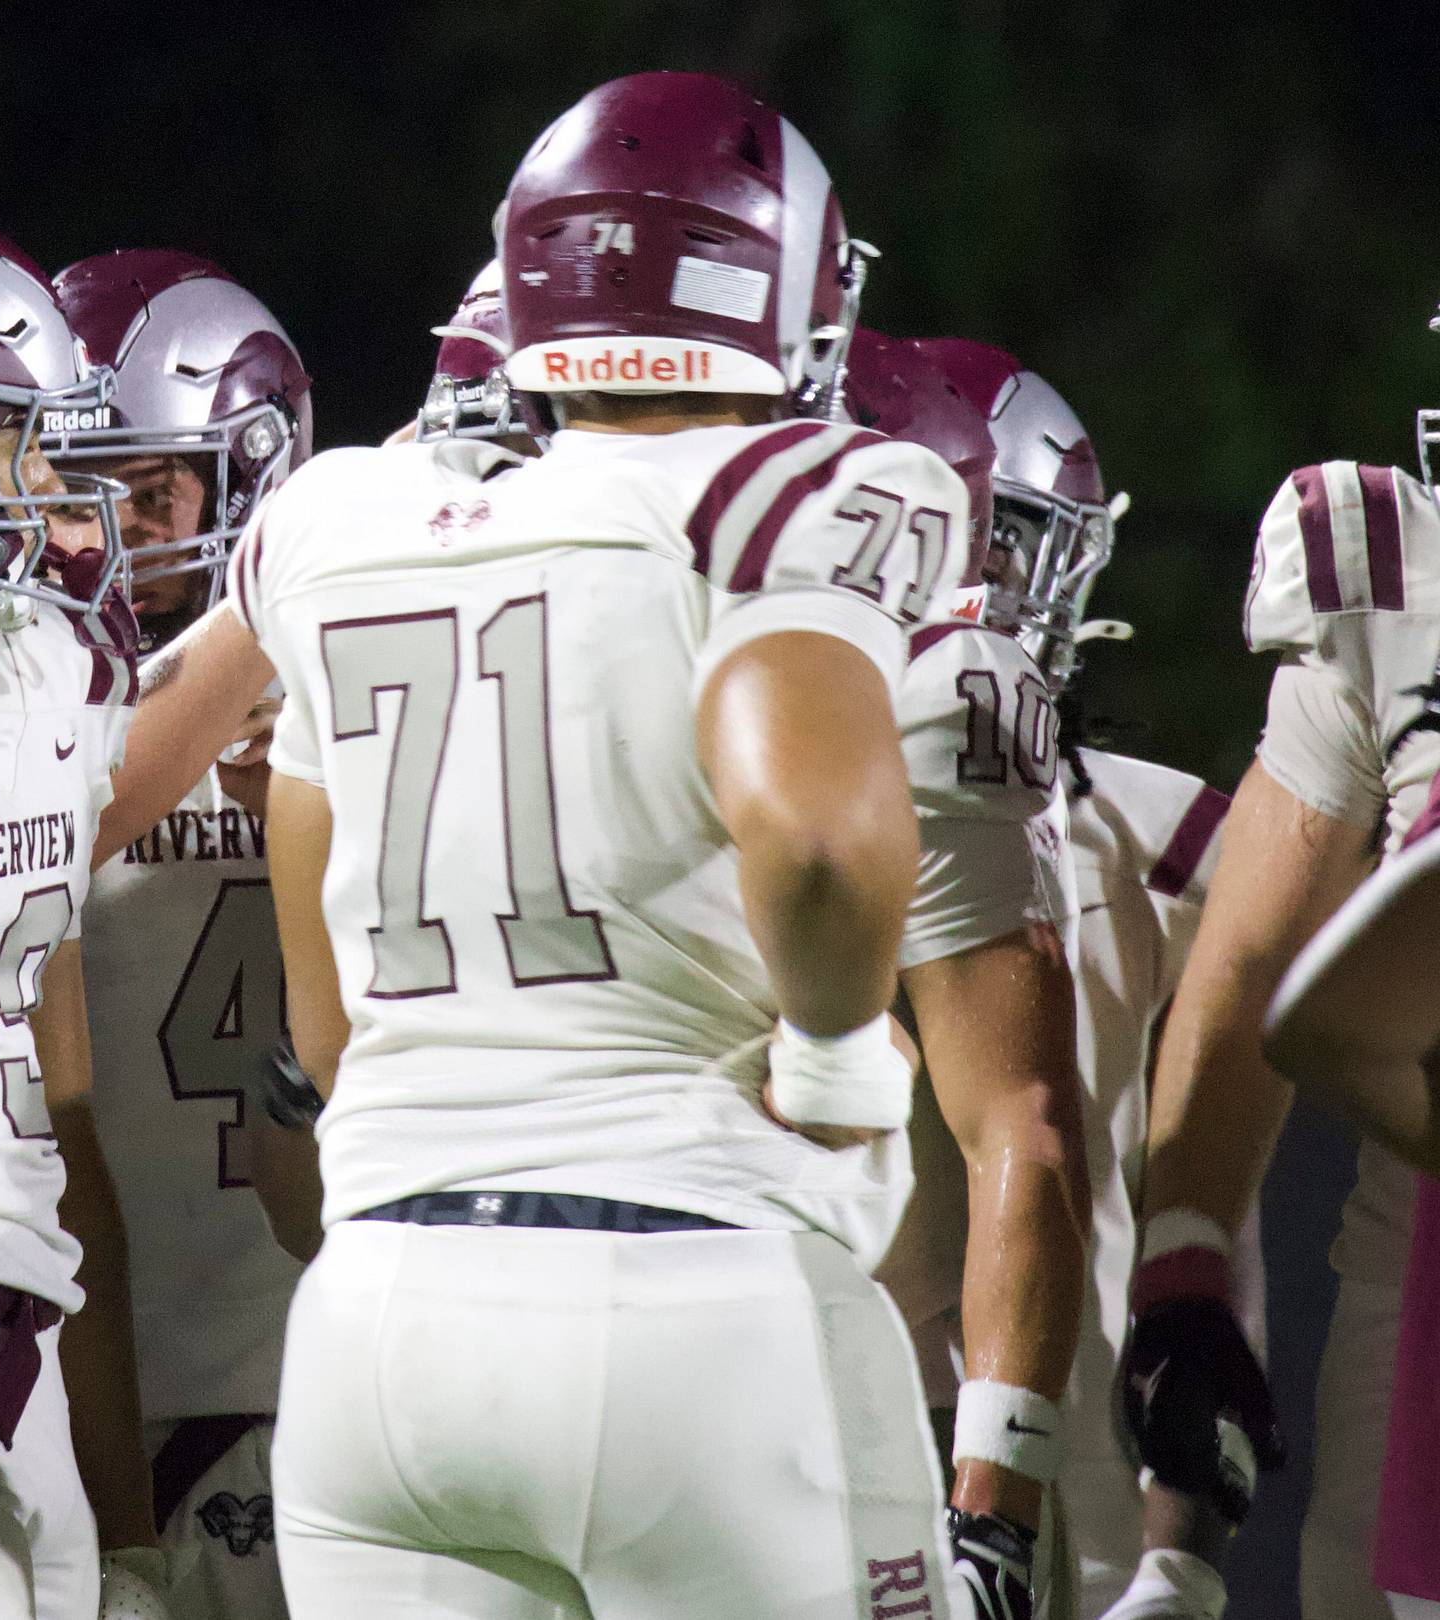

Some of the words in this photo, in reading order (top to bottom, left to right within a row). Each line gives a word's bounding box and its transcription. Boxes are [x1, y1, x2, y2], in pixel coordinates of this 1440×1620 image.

[592, 222, 634, 255] 74
[43, 407, 110, 432] iddell
[544, 348, 712, 383] Riddell
[831, 483, 951, 622] 71
[956, 669, 1059, 793] 10
[319, 590, 620, 999] 71
[157, 877, 289, 1190] 4
